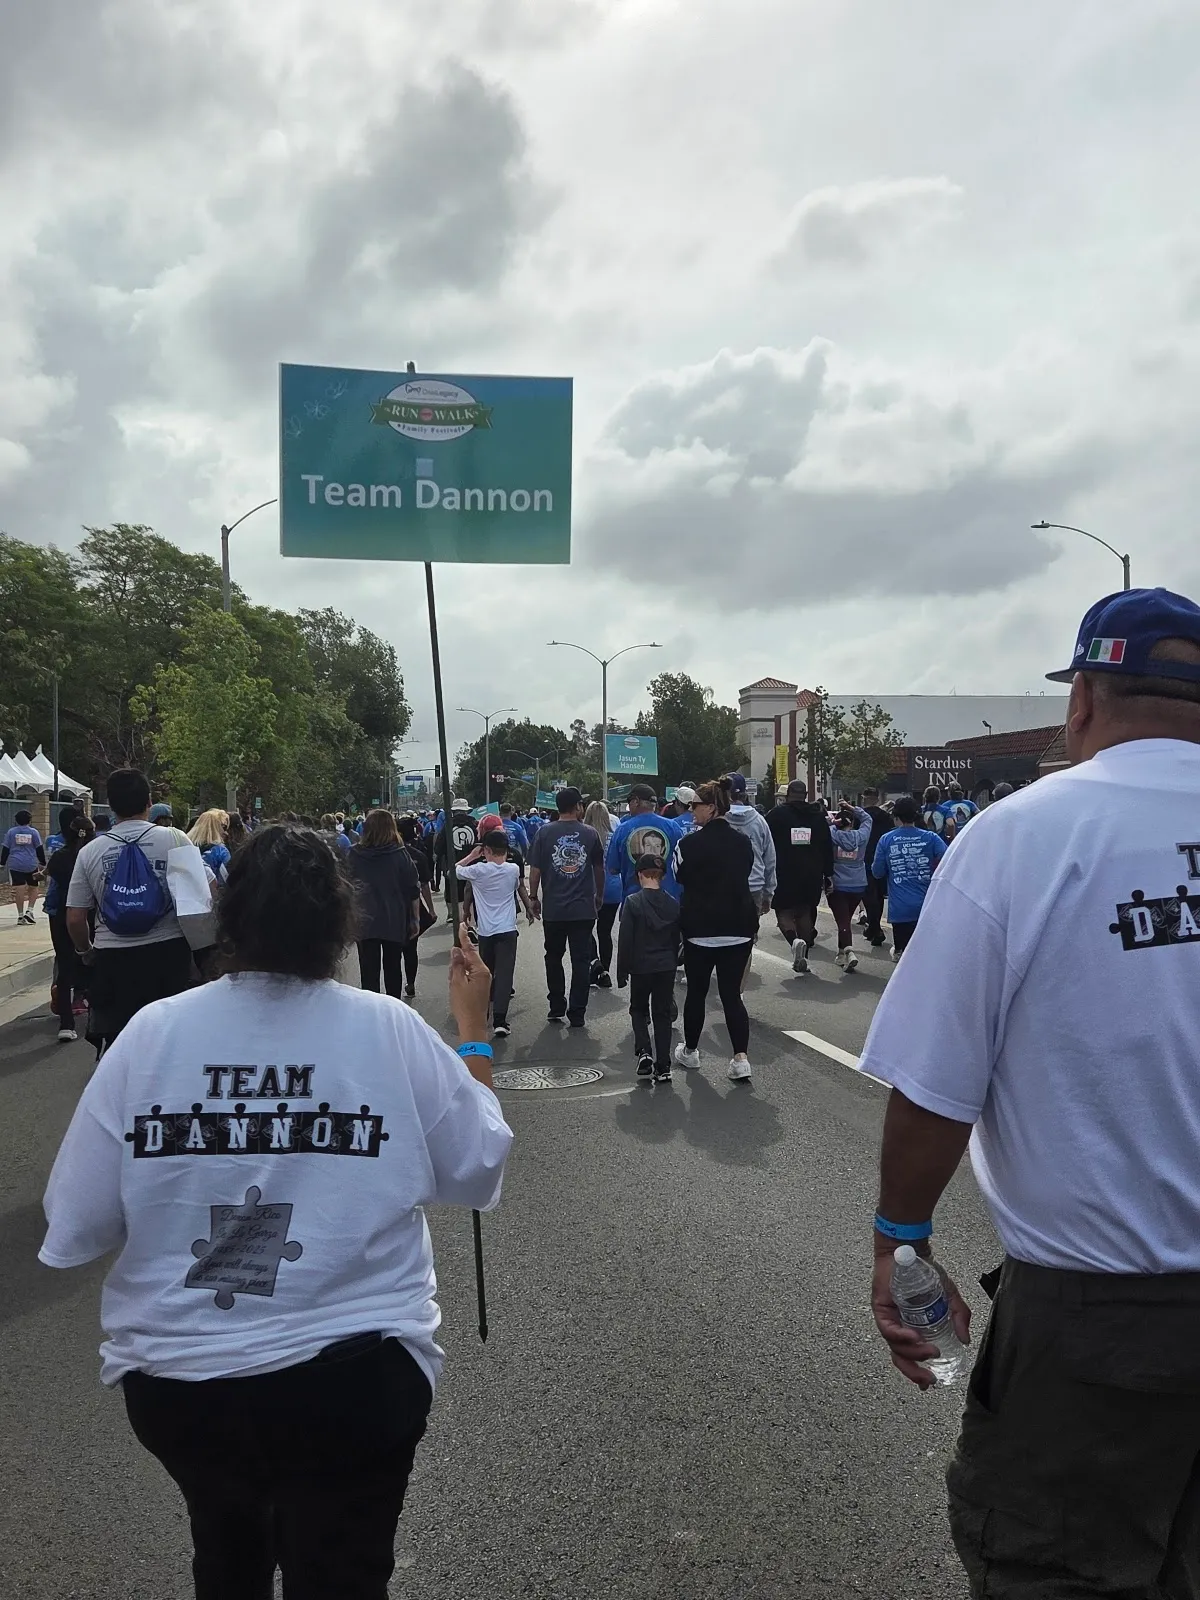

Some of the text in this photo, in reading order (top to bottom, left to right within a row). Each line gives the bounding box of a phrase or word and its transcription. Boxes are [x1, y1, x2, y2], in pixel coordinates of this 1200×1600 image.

[391, 404, 419, 419] RUN
[434, 408, 474, 421] WALK
[301, 474, 553, 512] Team Dannon
[620, 762, 645, 770] Hansen
[638, 755, 646, 764] Ty
[915, 755, 972, 769] Stardust
[929, 771, 959, 786] INN
[203, 1064, 315, 1100] TEAM
[144, 1117, 373, 1152] DANNON
